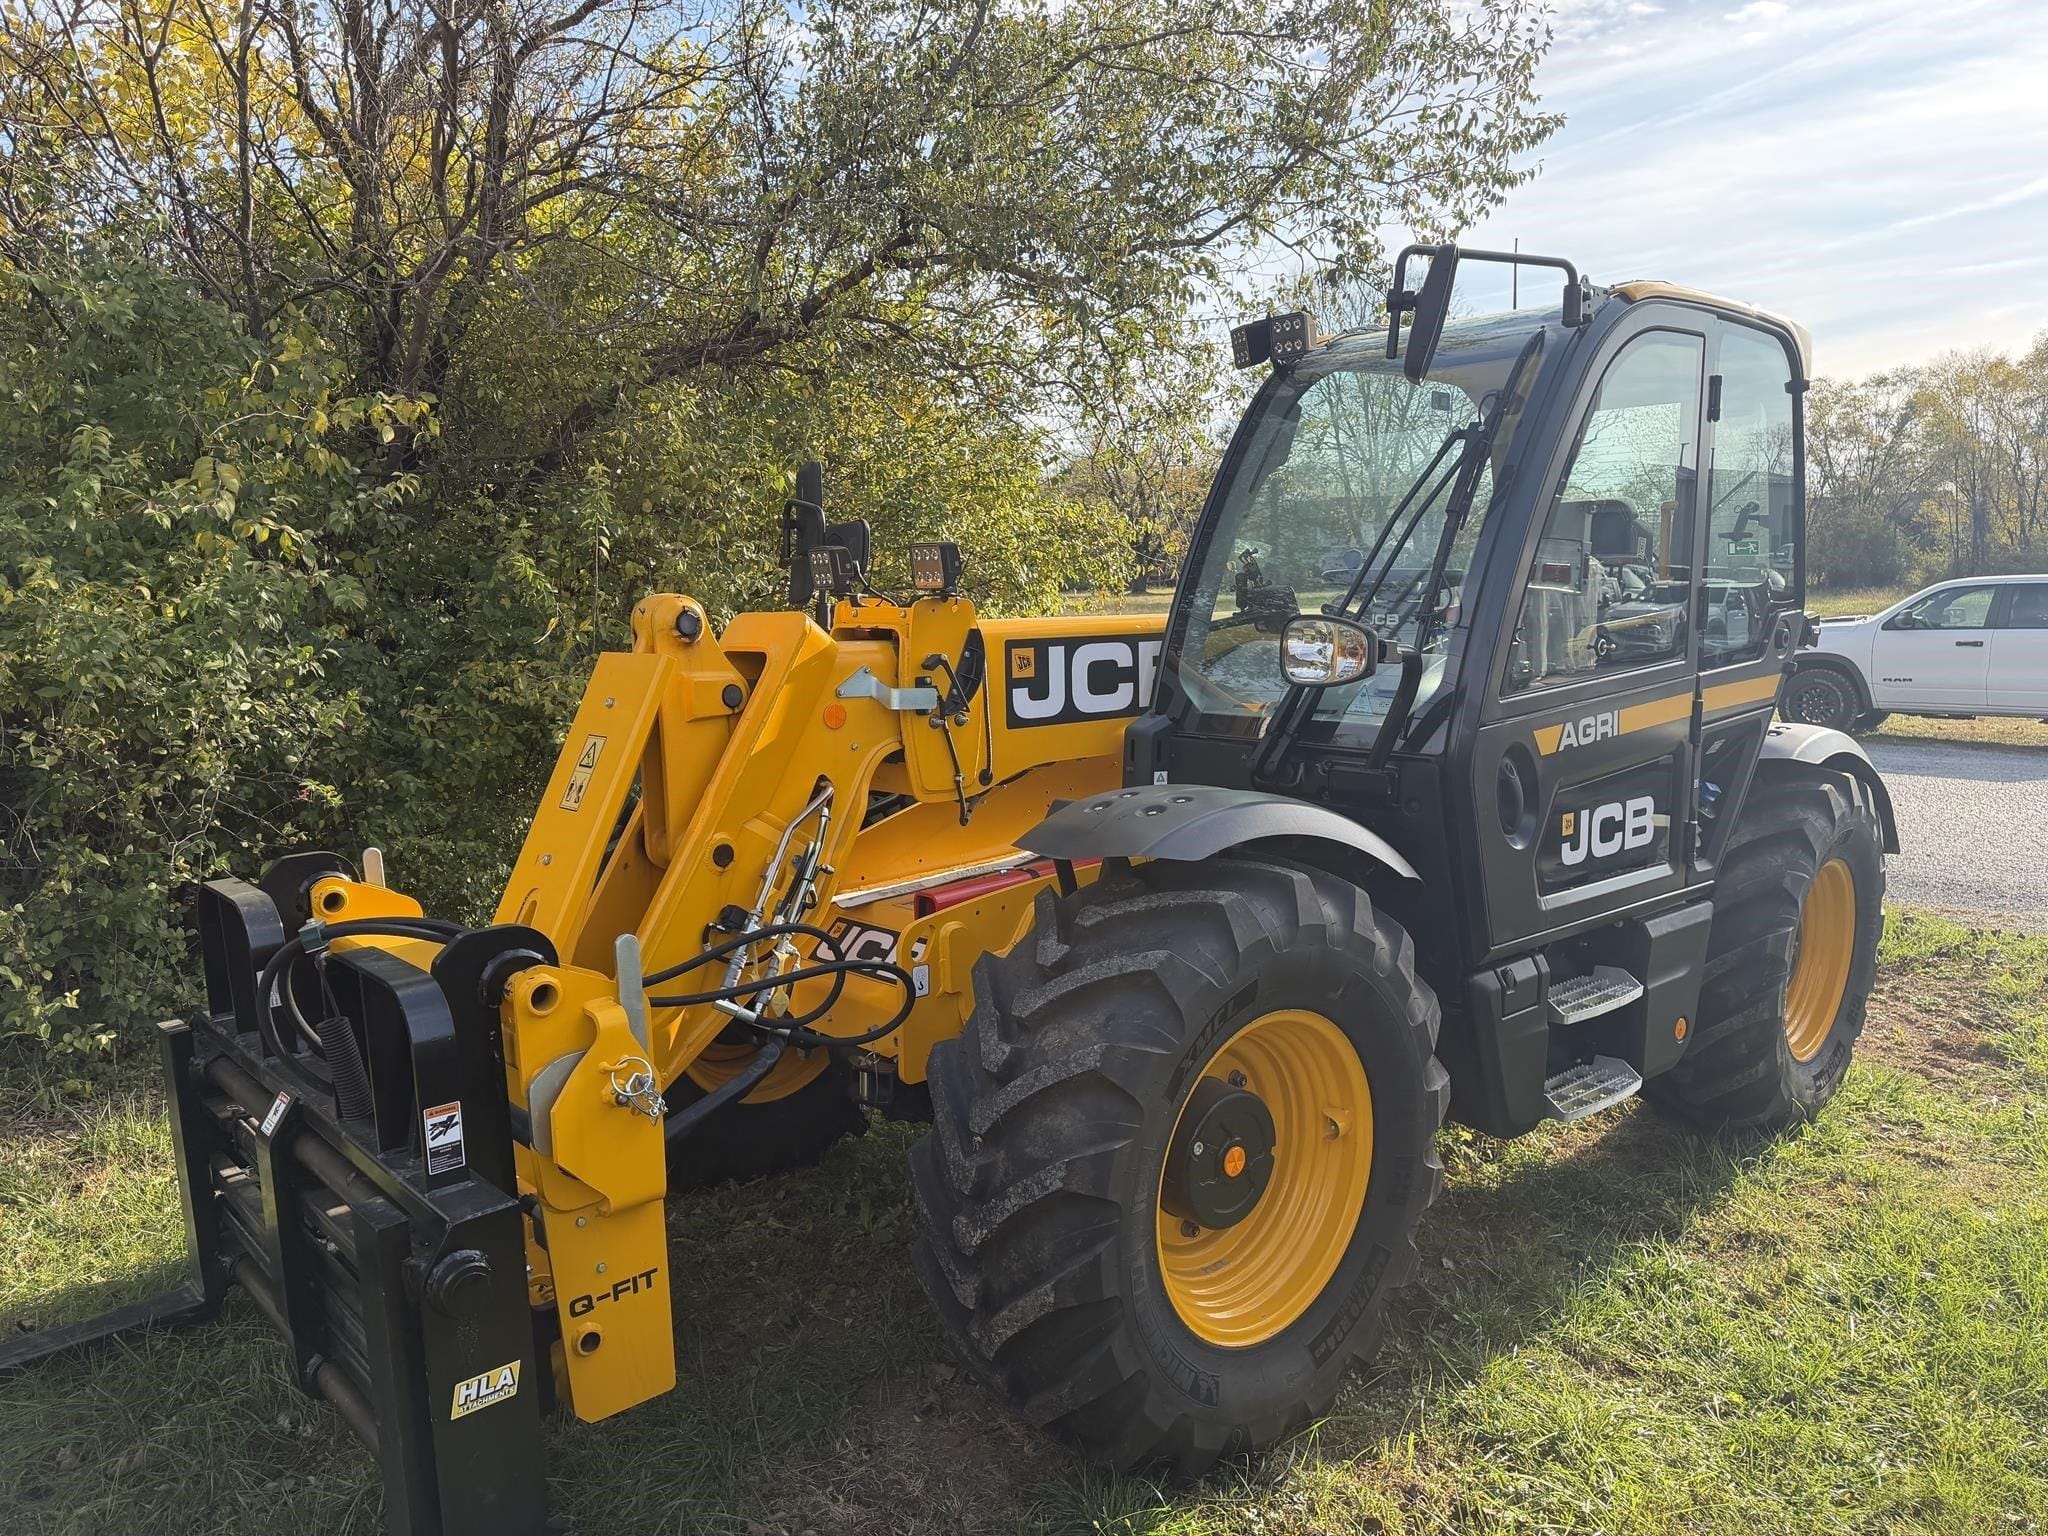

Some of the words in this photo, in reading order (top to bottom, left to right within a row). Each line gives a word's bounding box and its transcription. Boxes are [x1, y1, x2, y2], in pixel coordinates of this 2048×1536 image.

[1369, 613, 1399, 625] JCB
[1558, 709, 1619, 751] AGRI
[1561, 796, 1655, 865] JCB
[569, 1267, 658, 1318] Q-FIT
[457, 1387, 515, 1414] ATTACHMENTS
[458, 1367, 515, 1407] HLA
